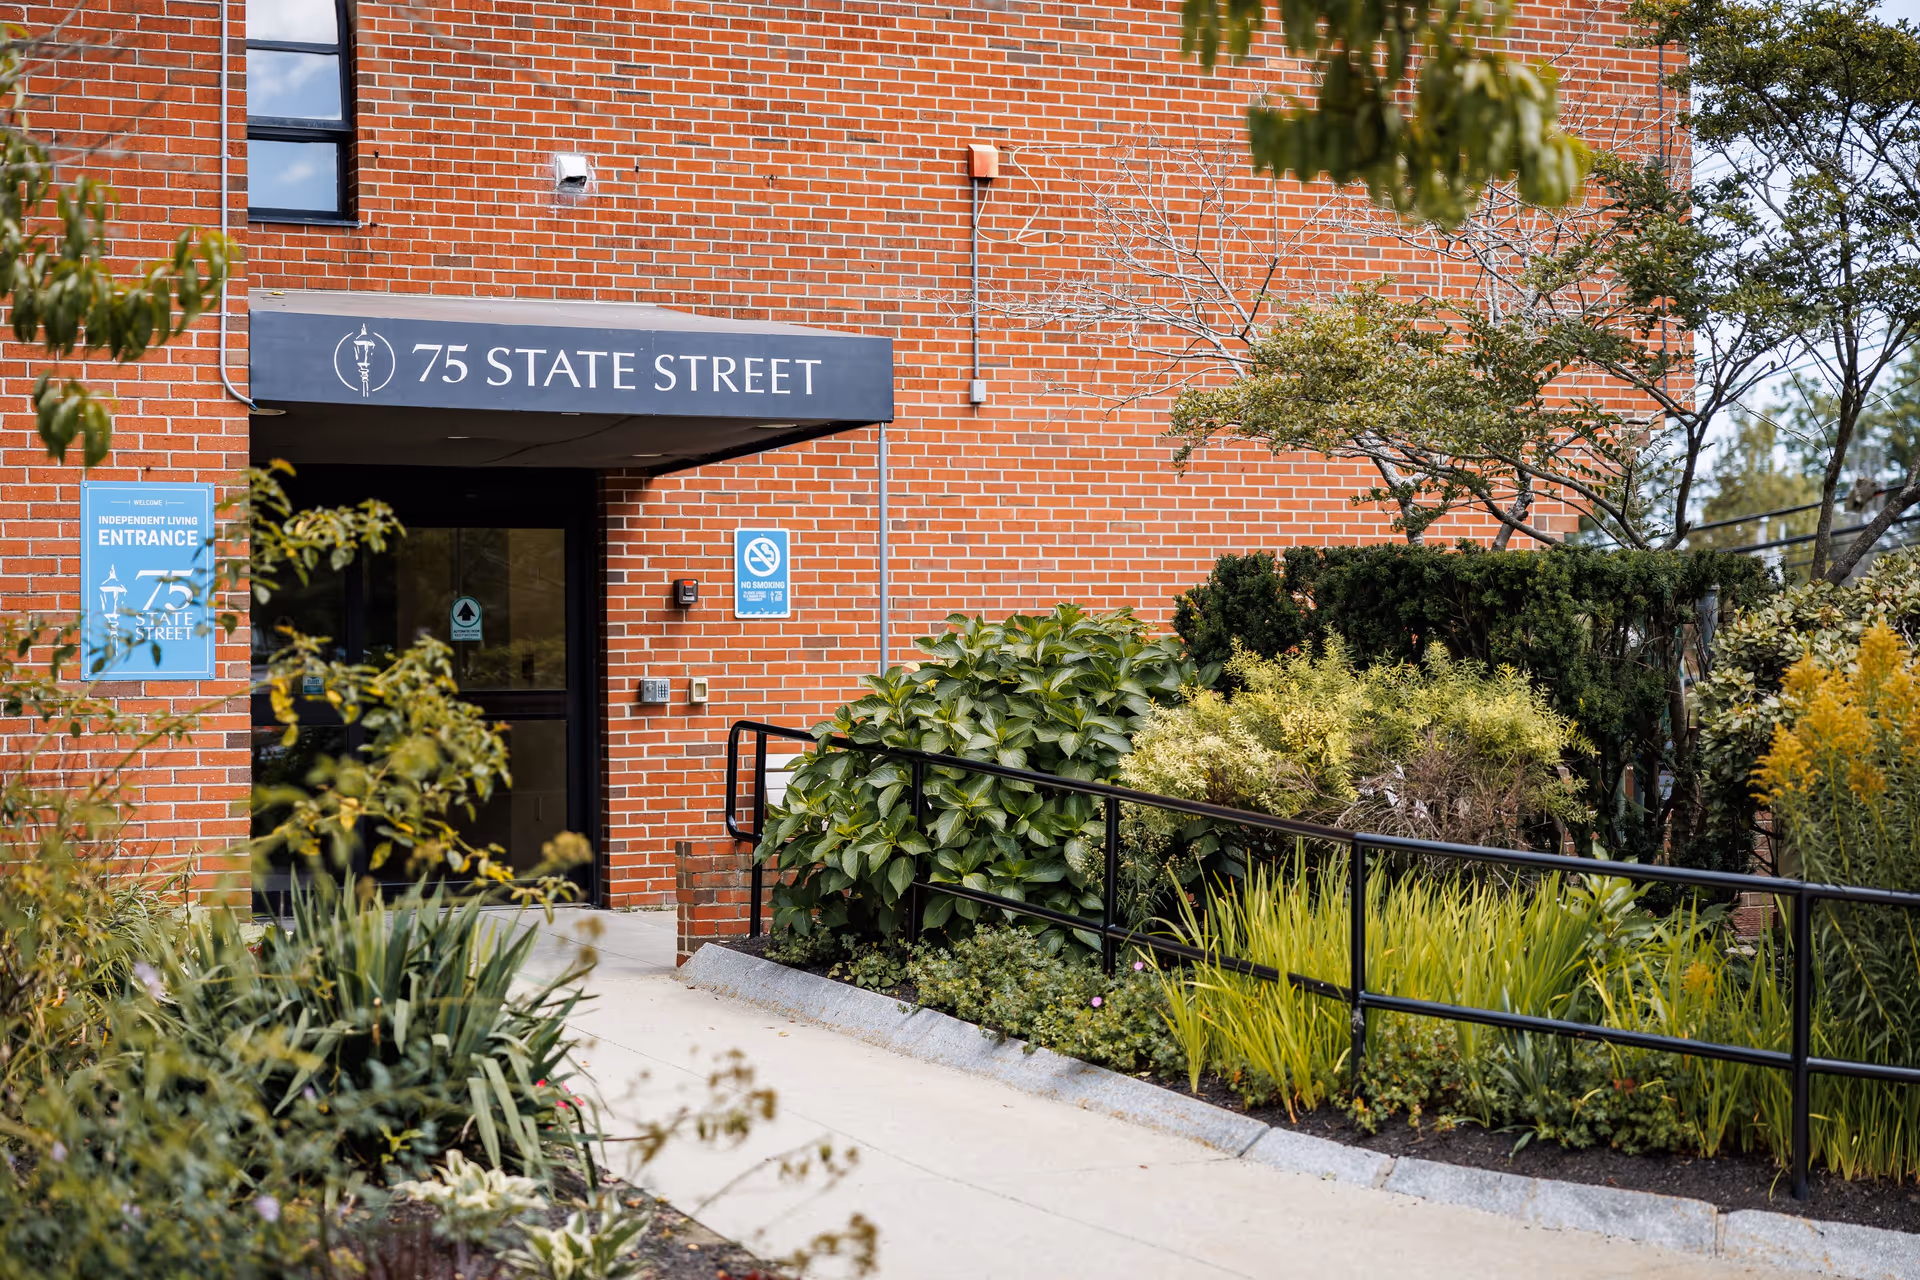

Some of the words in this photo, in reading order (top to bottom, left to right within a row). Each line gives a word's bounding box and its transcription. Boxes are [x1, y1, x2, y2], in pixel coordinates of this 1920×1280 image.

[411, 343, 468, 383] 75
[486, 347, 636, 390] STATE
[654, 354, 822, 395] STREET
[99, 516, 166, 525] INDEPENDENT
[167, 516, 198, 526] LIVING
[98, 529, 198, 546] ENTRANCE
[135, 568, 194, 611] 75
[741, 581, 752, 589] NO
[752, 581, 785, 589] SMOKING
[135, 612, 194, 626] STATE
[135, 626, 194, 640] STREET
